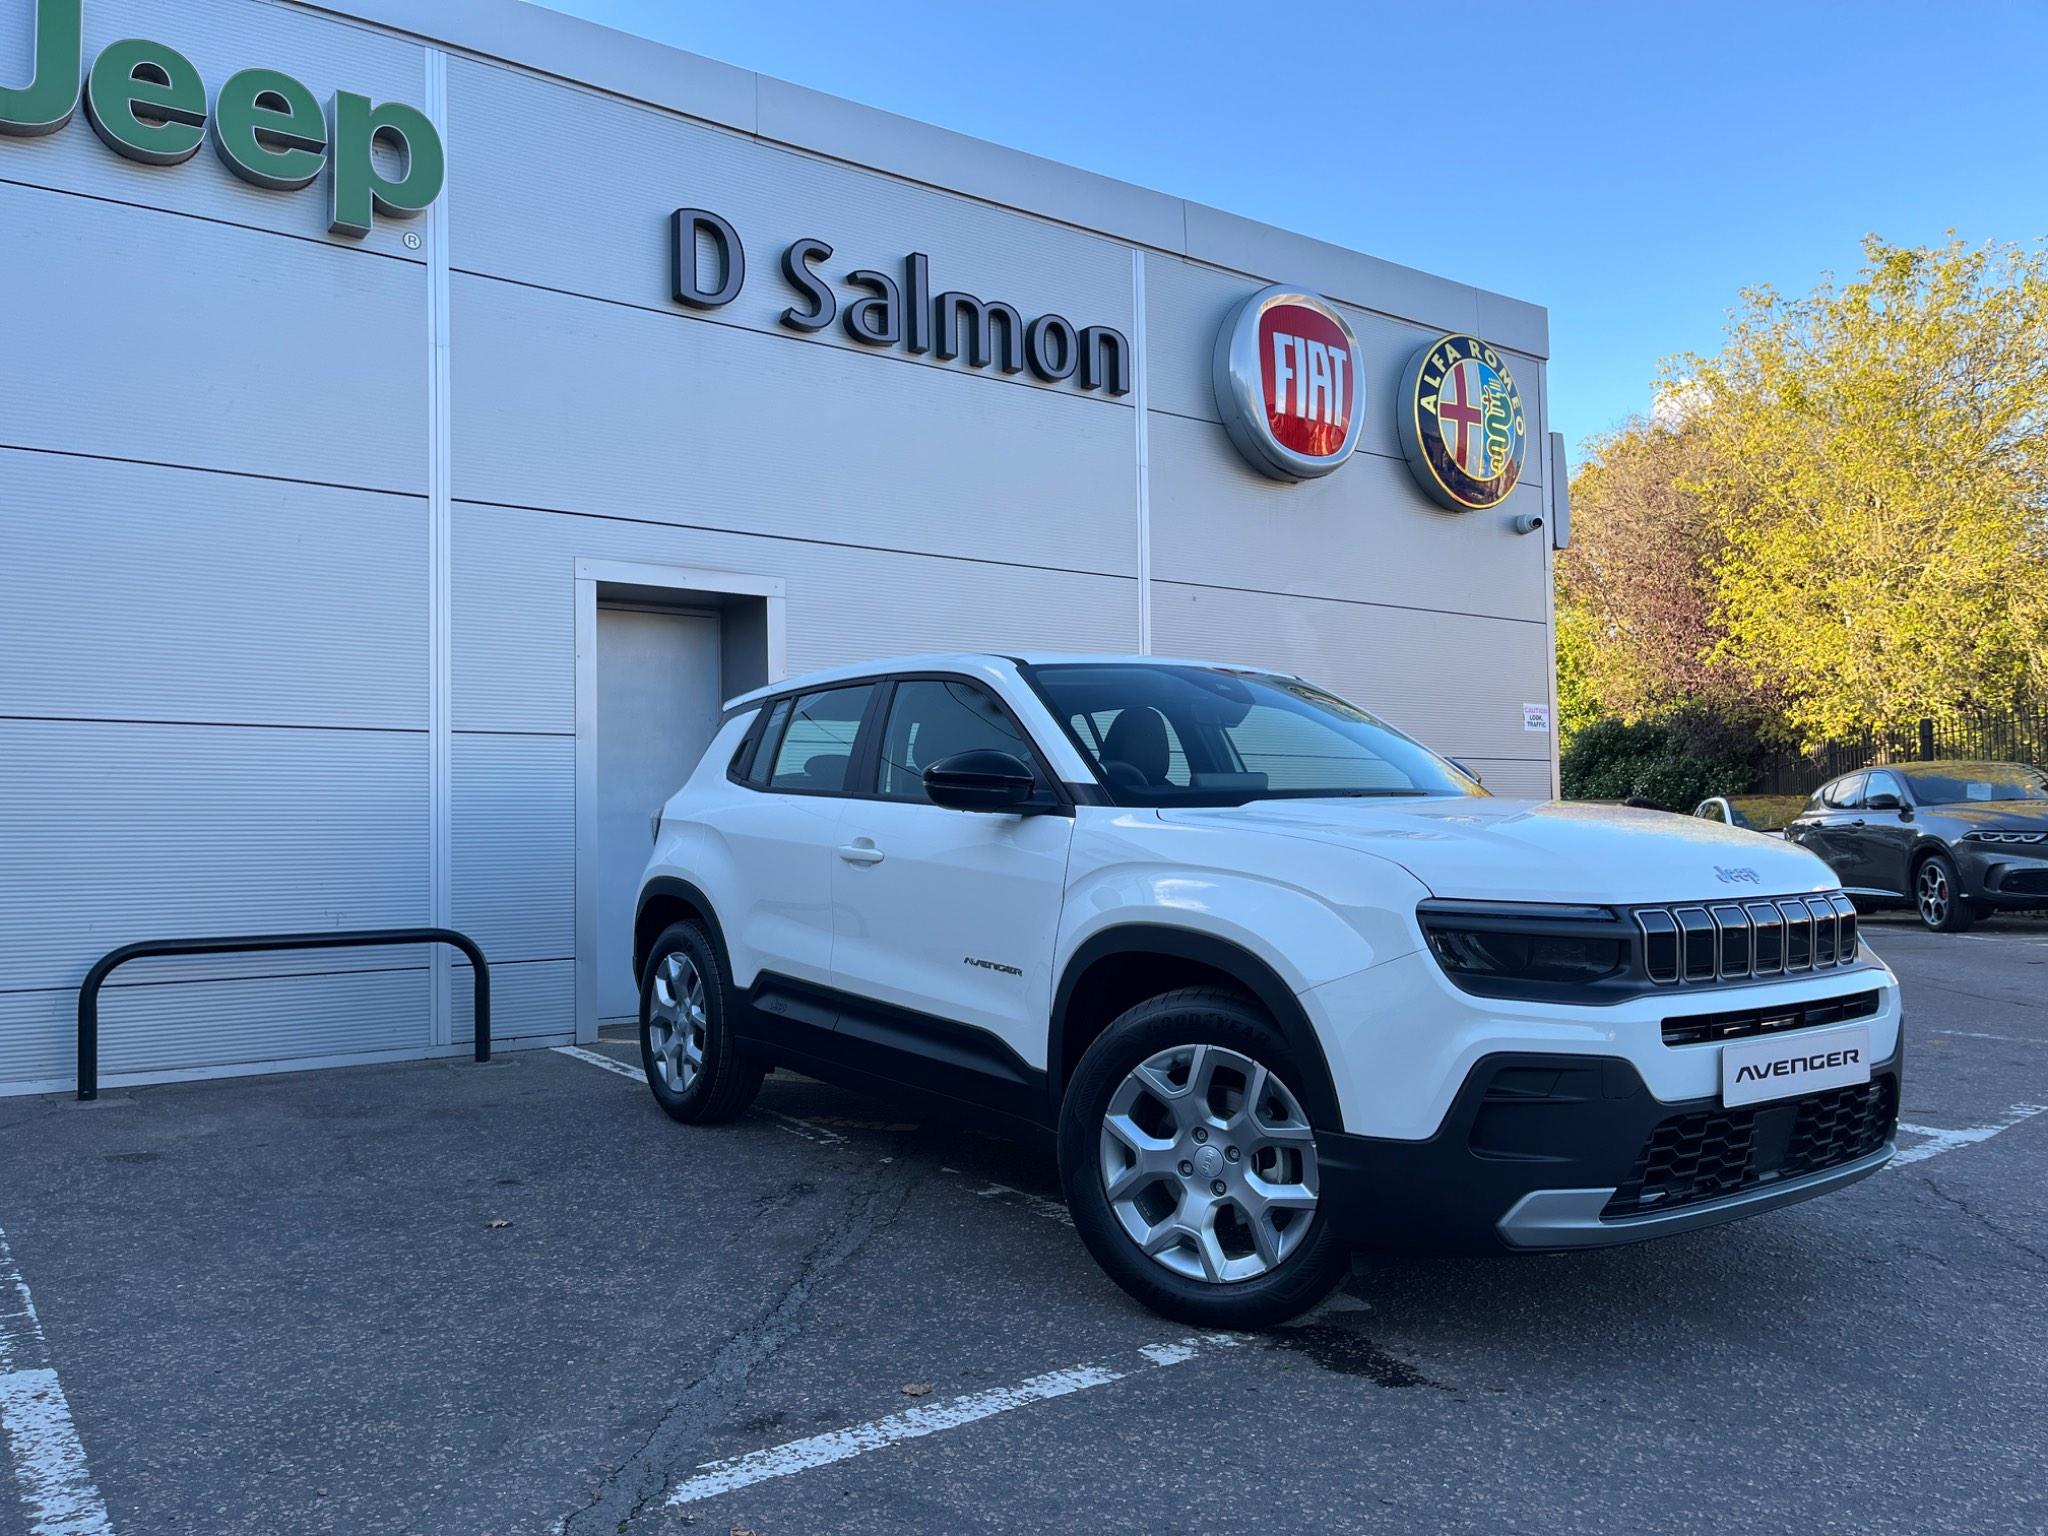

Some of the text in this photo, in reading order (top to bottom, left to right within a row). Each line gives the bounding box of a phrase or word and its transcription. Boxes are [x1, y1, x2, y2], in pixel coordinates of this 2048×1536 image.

[0, 0, 444, 237] Jeep
[671, 208, 1130, 396] D Salmon
[1272, 331, 1347, 428] FIAT
[1420, 339, 1525, 437] ALFA ROMEO
[1712, 865, 1761, 885] Jeep
[964, 957, 1022, 977] AVENGER
[1736, 1048, 1860, 1084] AVENGER
